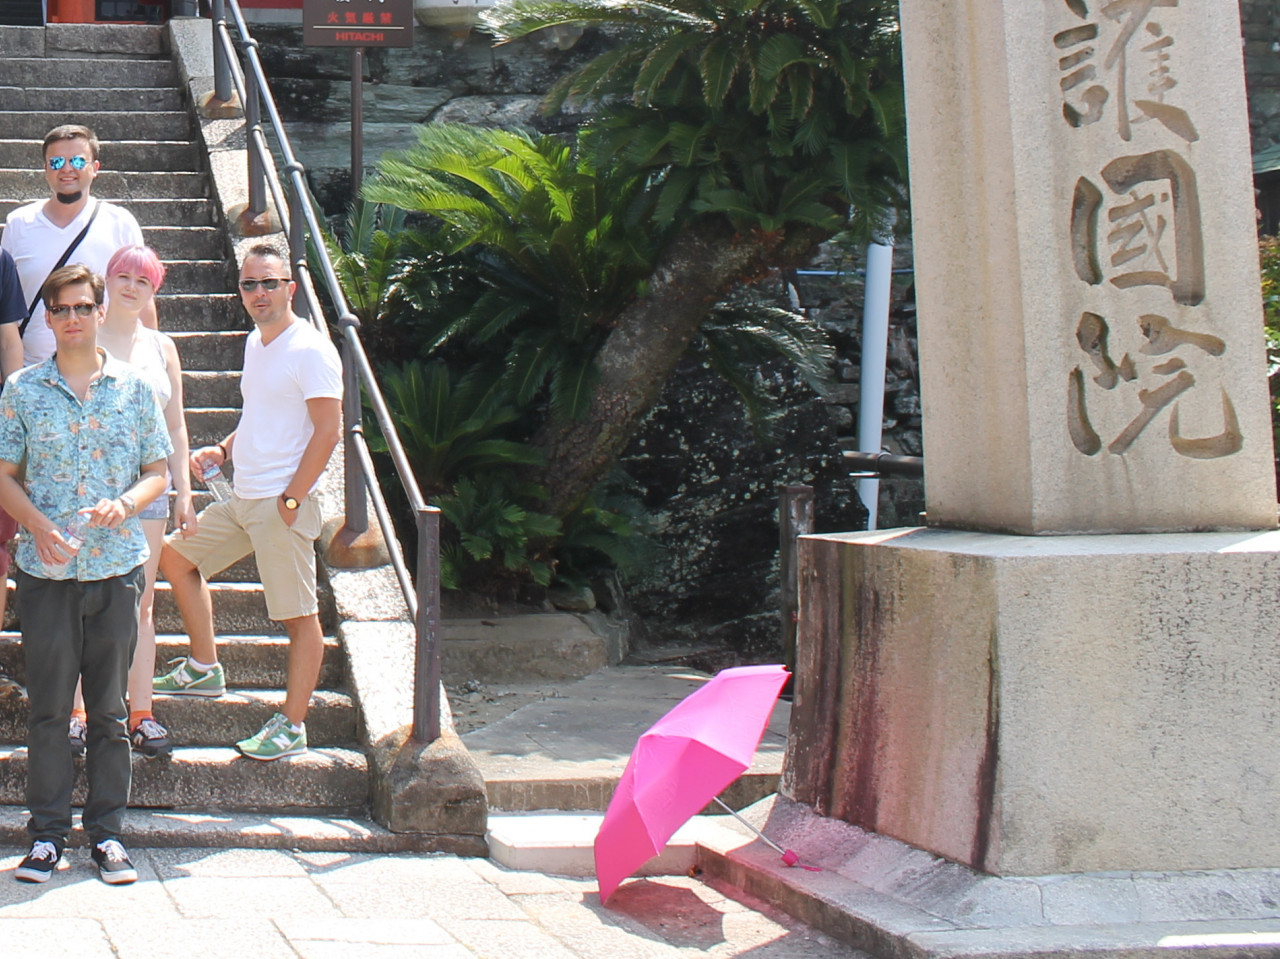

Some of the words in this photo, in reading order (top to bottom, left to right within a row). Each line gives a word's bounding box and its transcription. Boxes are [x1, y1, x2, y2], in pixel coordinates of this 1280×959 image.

[327, 12, 392, 24] 火気厳禁
[336, 33, 384, 41] HITACHI
